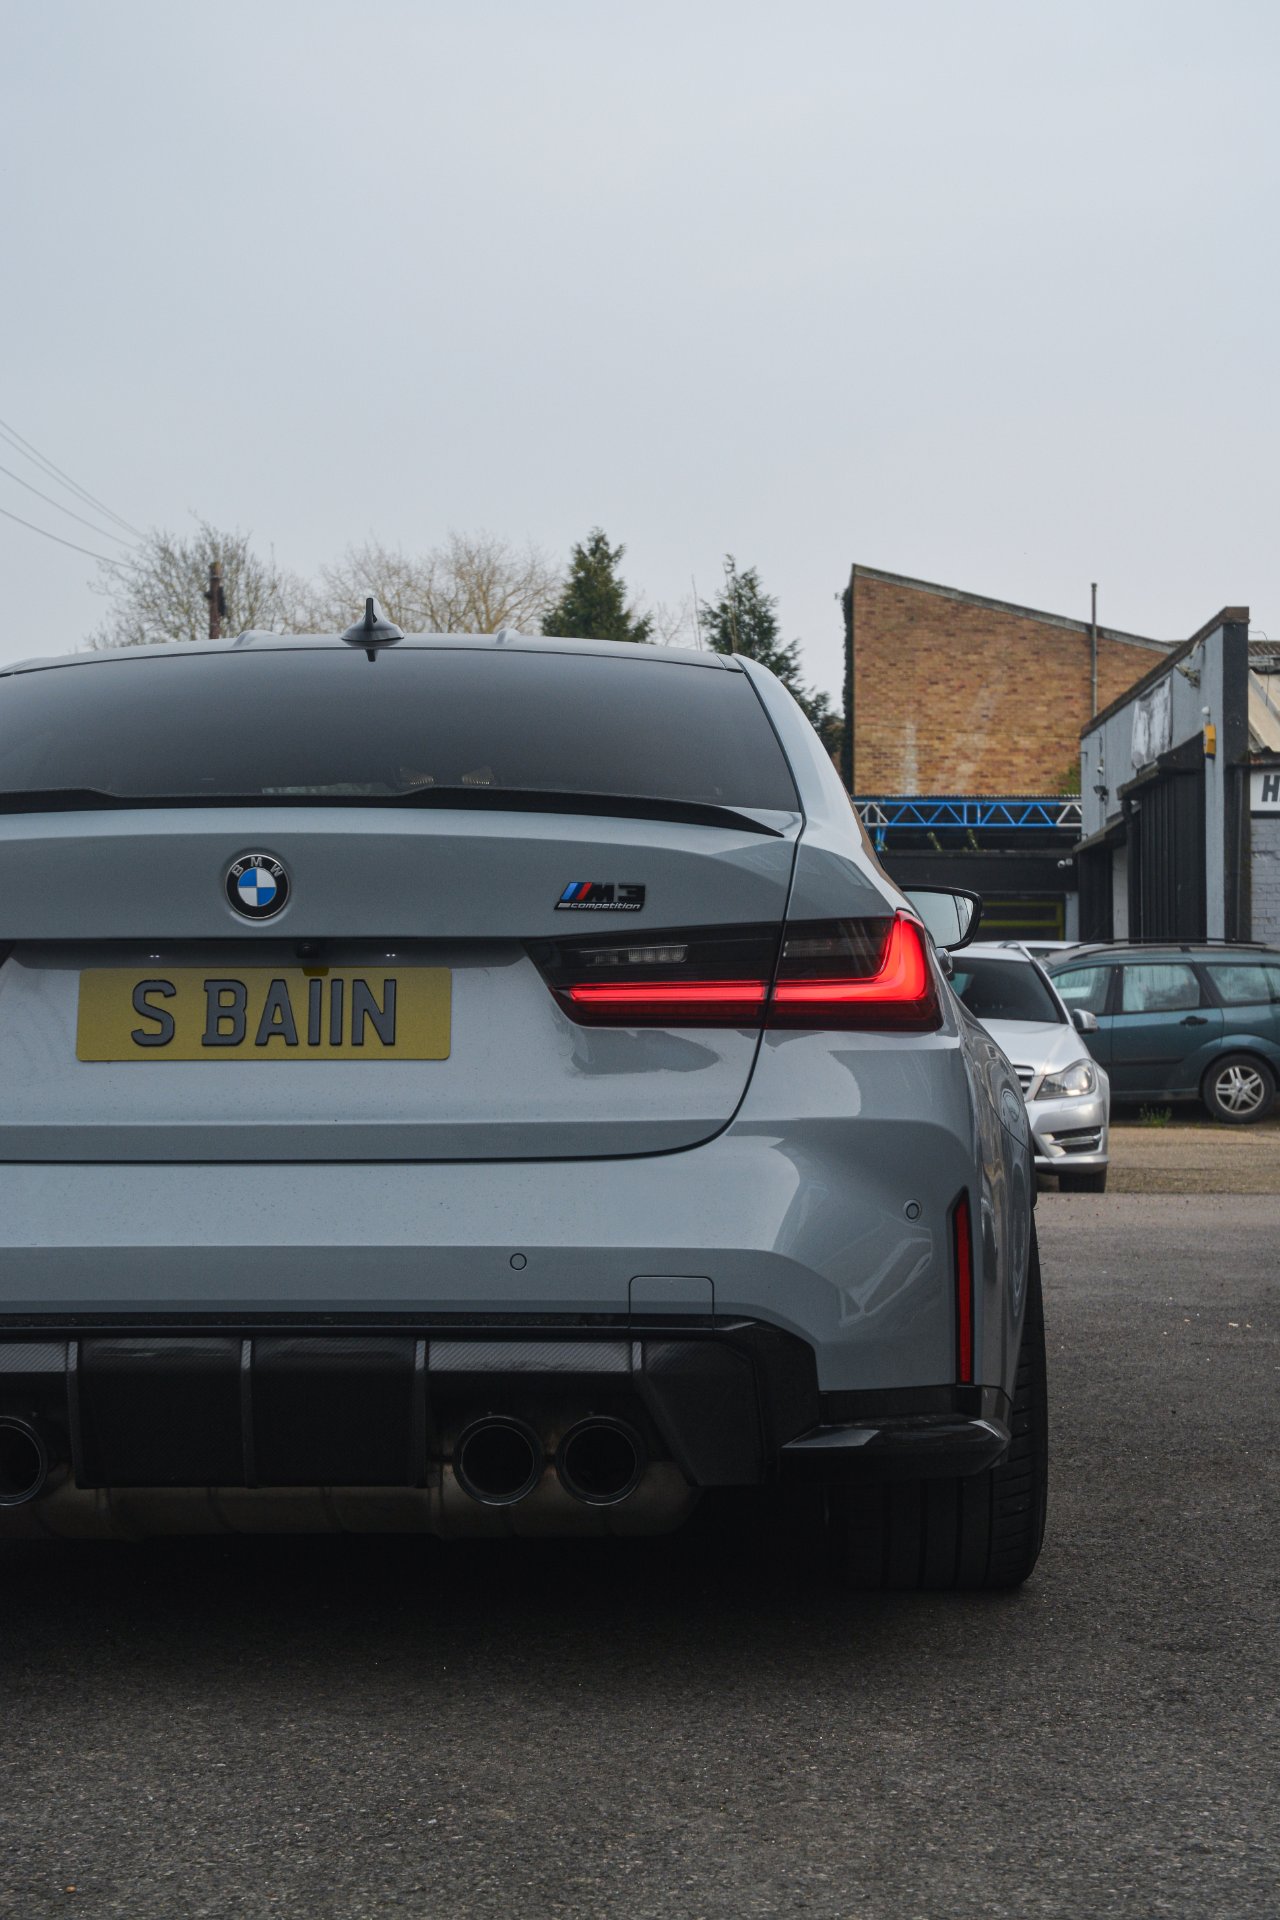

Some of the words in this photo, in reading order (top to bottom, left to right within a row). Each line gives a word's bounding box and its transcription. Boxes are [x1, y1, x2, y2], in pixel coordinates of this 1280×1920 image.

[1261, 774, 1280, 802] H
[231, 856, 283, 877] BMW
[585, 882, 646, 902] M3
[570, 902, 641, 910] competition
[131, 979, 177, 1047] S
